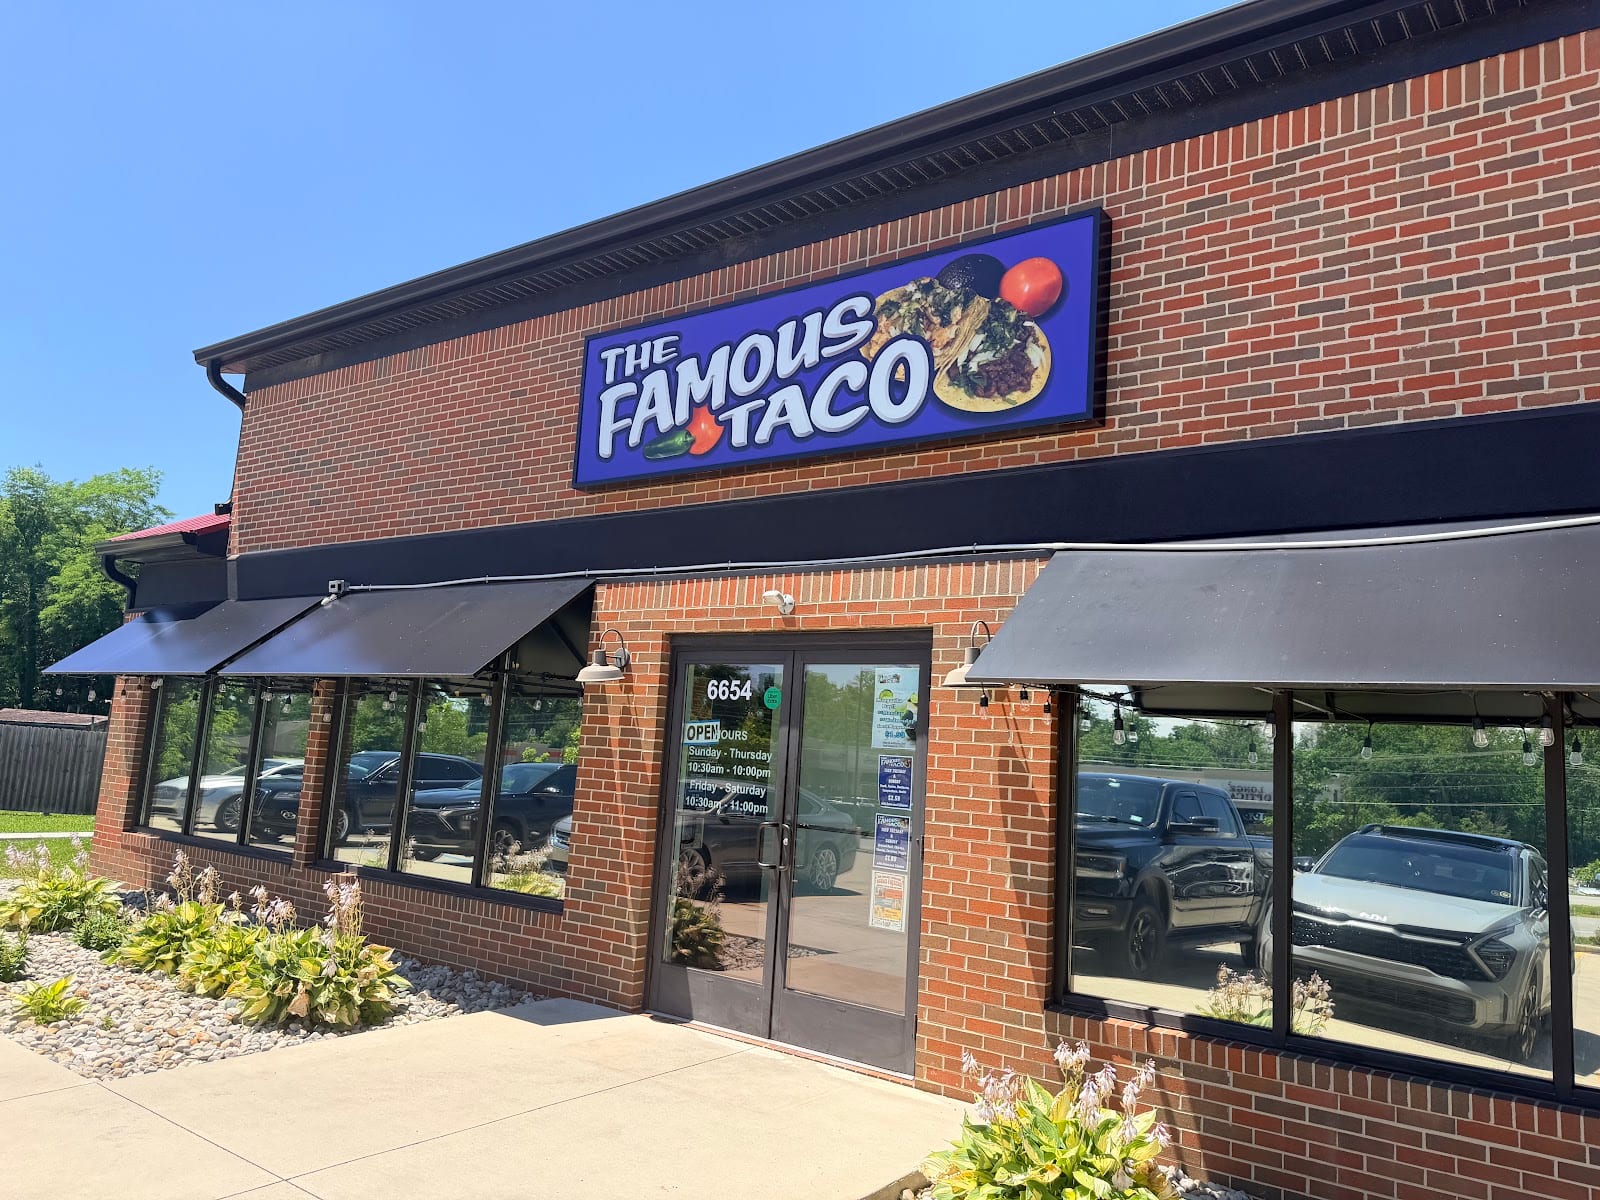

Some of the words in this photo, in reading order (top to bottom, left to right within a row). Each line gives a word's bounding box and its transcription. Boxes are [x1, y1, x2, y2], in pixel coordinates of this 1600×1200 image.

[600, 334, 680, 385] THE
[598, 295, 876, 459] FAMOUS
[717, 338, 930, 448] TACO
[707, 679, 752, 700] 6654
[686, 725, 718, 741] OPEN
[688, 746, 721, 759] Sunday
[729, 747, 772, 763] Thursday
[688, 762, 724, 774] 10:30am
[732, 765, 771, 779] 10:00pm
[689, 780, 717, 794] Friday
[725, 782, 767, 798] Saturday
[685, 796, 721, 809] 10:30am
[730, 800, 768, 815] 11:00pm
